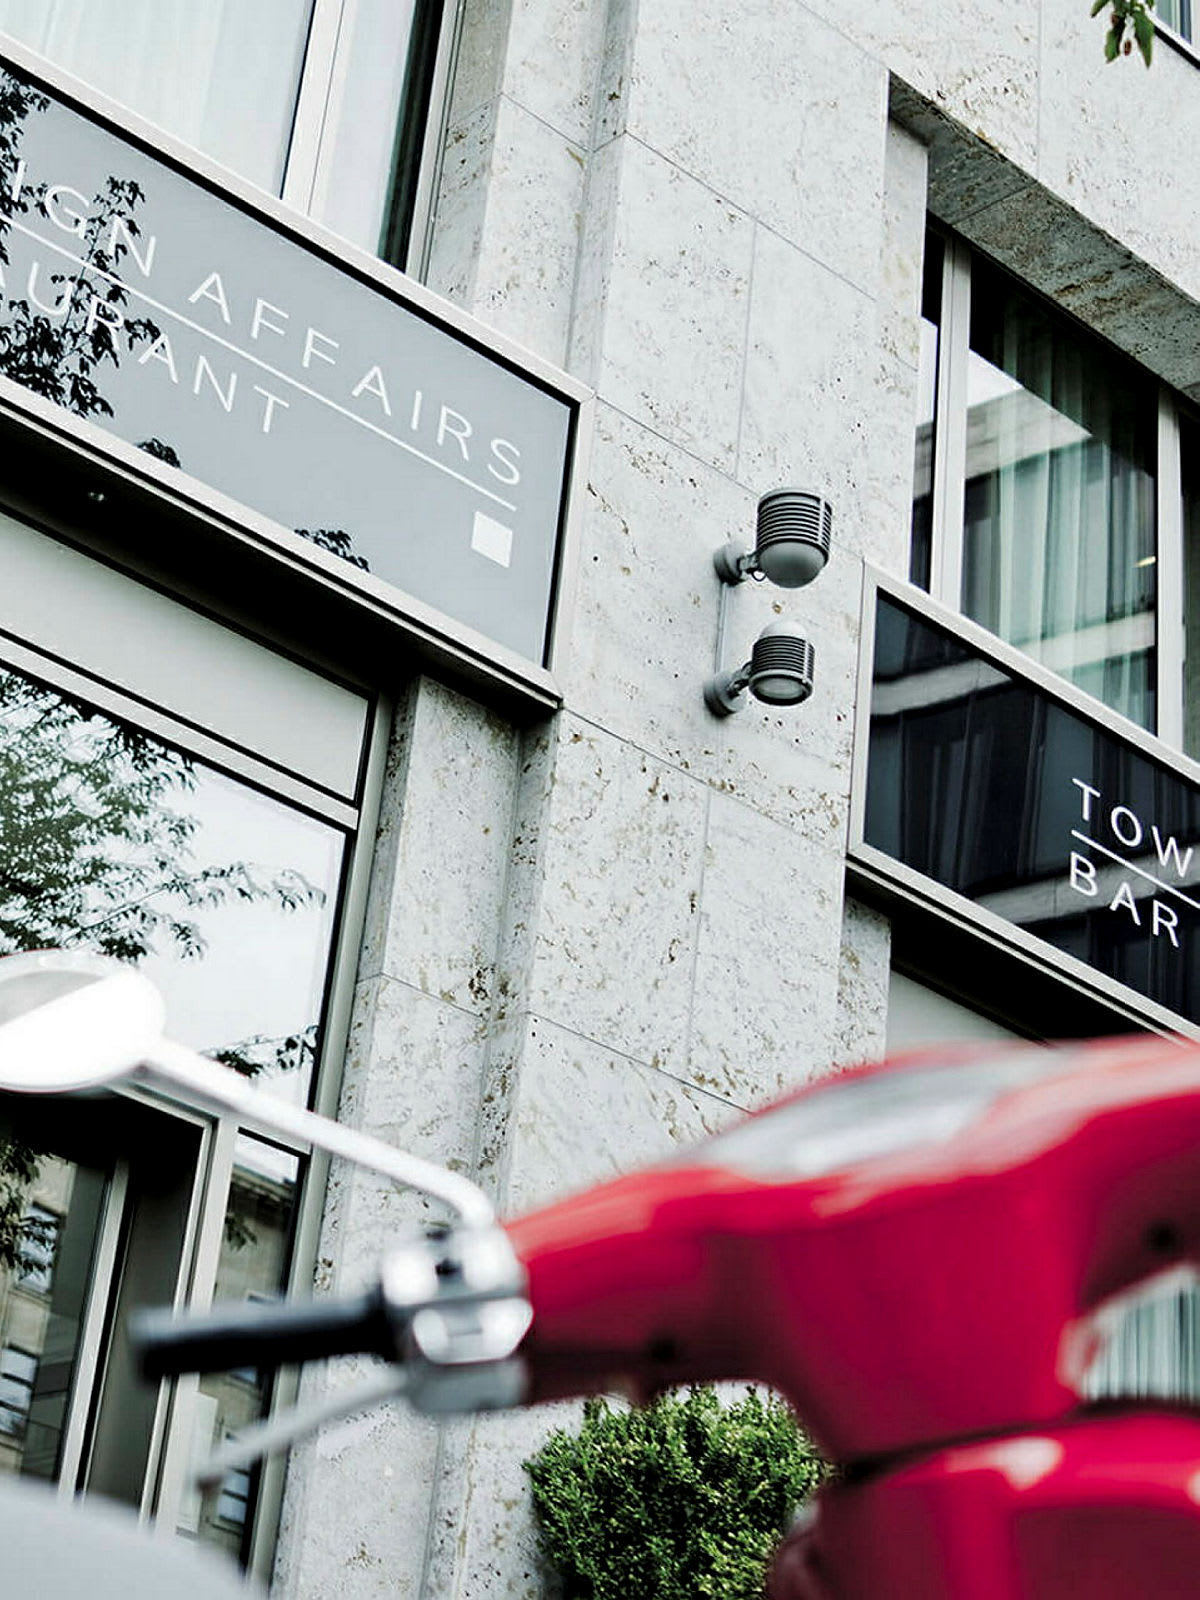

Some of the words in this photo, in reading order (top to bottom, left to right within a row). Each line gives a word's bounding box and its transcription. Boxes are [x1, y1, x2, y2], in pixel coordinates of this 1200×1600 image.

[188, 271, 521, 486] AFFAIRS
[1071, 777, 1194, 878] TOW
[1070, 850, 1179, 948] BAR
